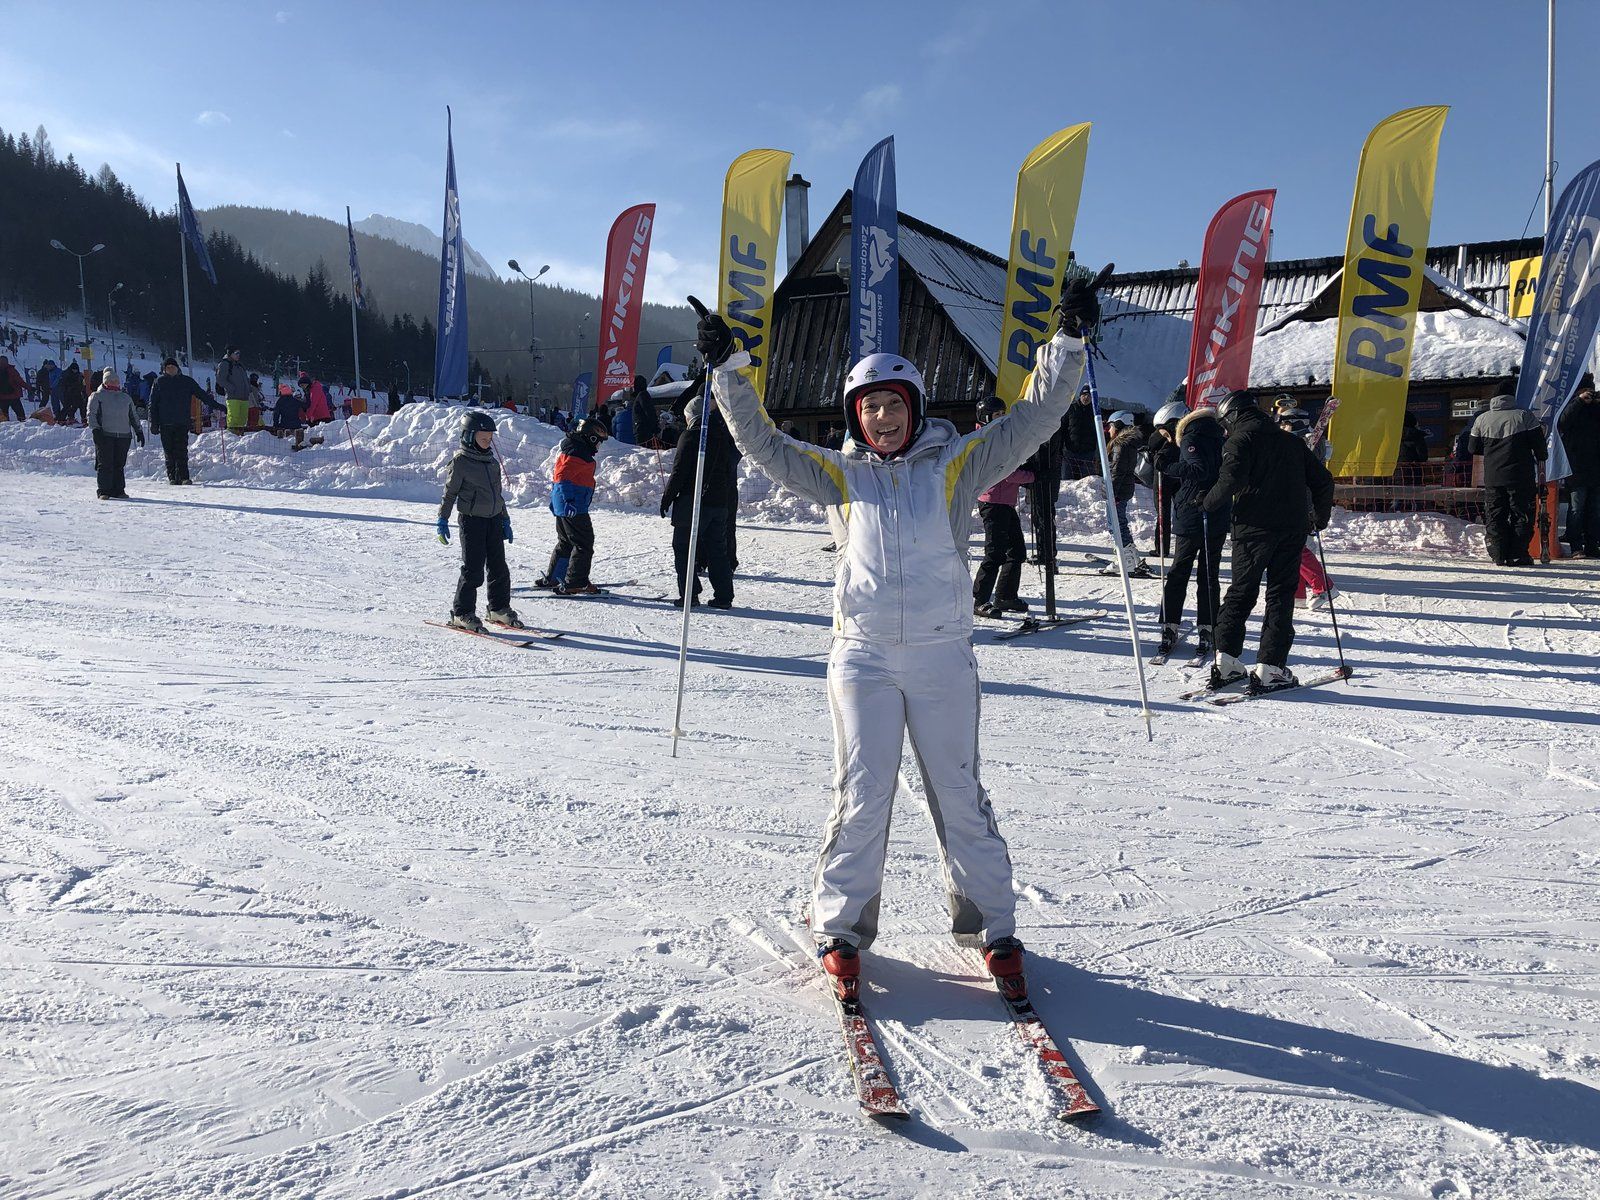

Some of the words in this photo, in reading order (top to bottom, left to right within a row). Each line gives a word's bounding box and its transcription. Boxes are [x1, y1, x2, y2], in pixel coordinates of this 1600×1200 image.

[605, 212, 651, 360] VIKING
[728, 235, 766, 367] RMF
[859, 225, 868, 289] Zakopane
[860, 289, 876, 360] STRA
[1007, 229, 1056, 371] RMF
[1195, 201, 1270, 385] VIKING
[1346, 214, 1413, 377] RMF
[1552, 214, 1578, 310] Zakopane
